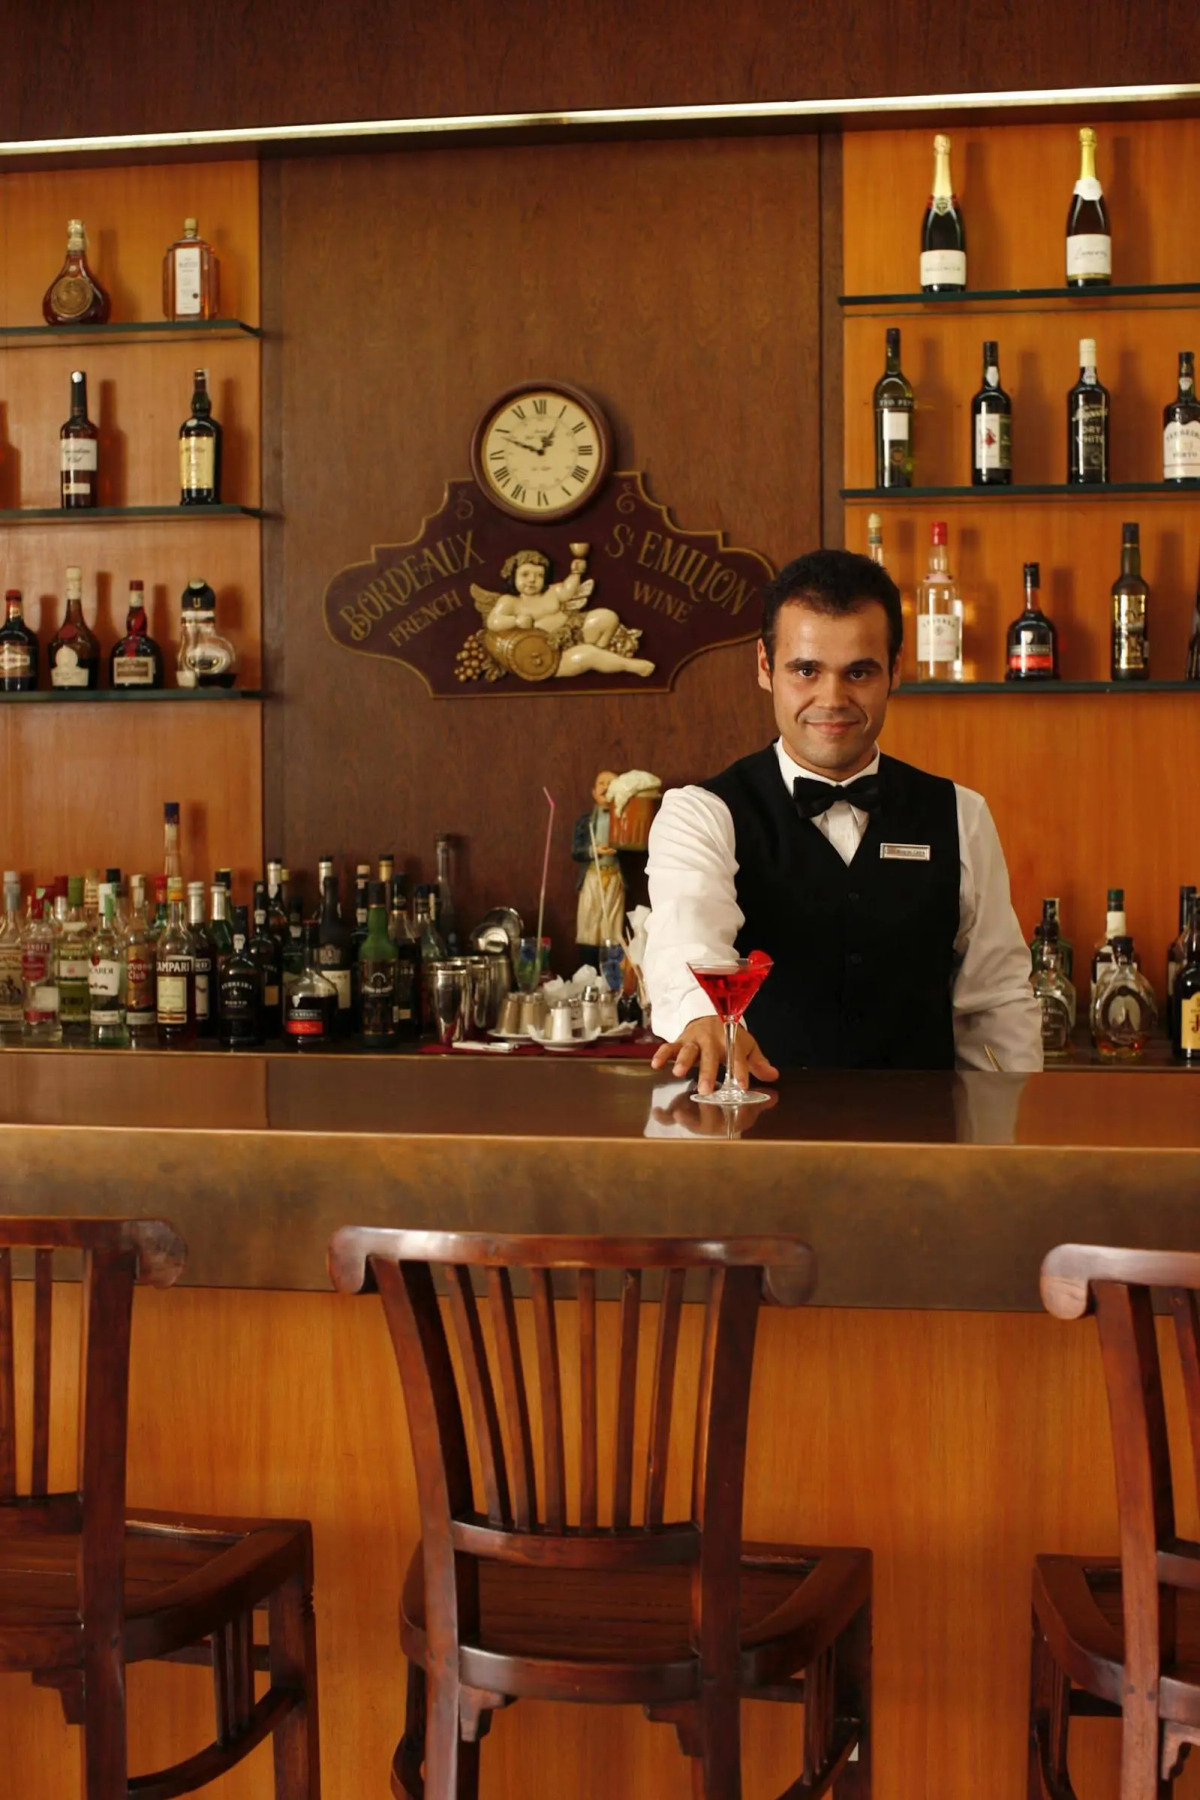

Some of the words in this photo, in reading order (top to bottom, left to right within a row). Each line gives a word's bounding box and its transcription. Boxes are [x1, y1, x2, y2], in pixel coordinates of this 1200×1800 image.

[339, 529, 487, 642] BORDEAUX
[632, 579, 694, 625] WINE
[636, 530, 759, 616] EMILION
[387, 588, 463, 648] FRENCH
[156, 960, 191, 973] AMPARI
